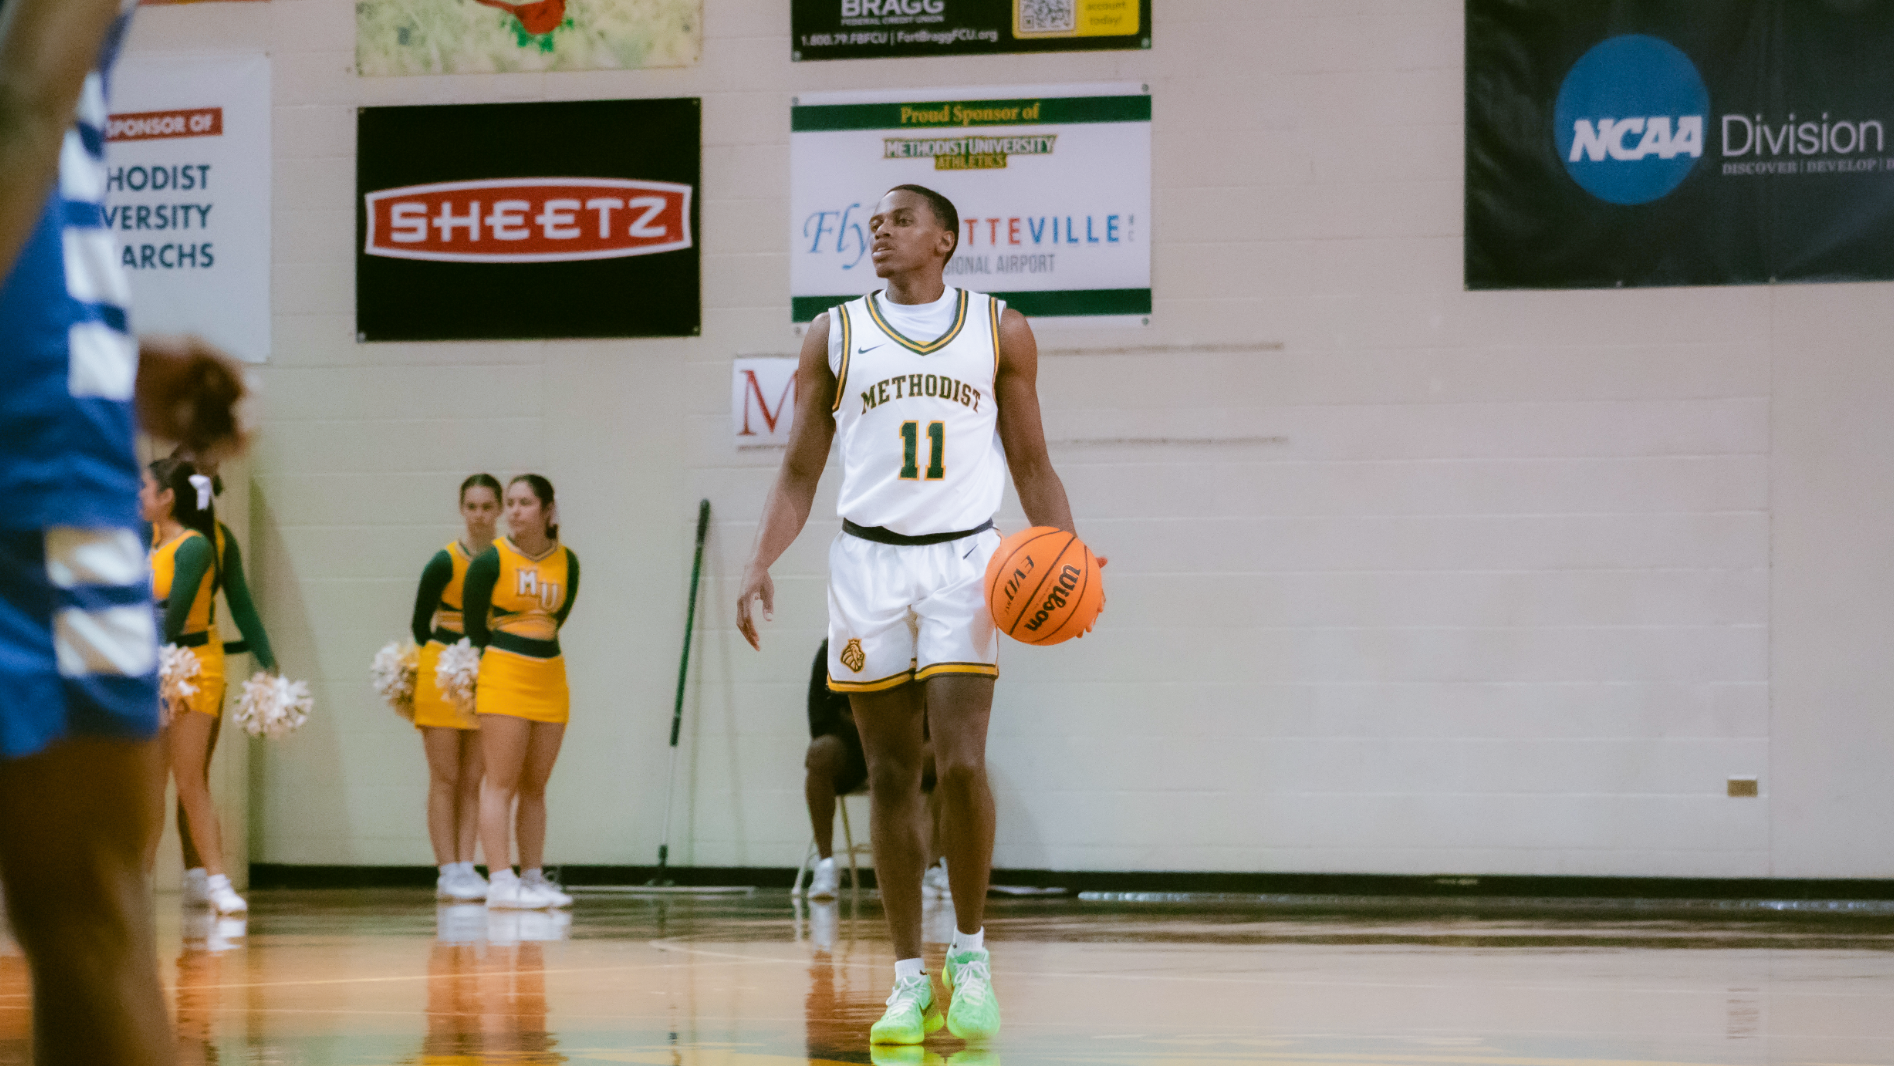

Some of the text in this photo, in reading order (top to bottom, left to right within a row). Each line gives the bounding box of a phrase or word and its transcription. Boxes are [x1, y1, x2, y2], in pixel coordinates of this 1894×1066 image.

[841, 0, 945, 17] BRAGG
[901, 102, 1039, 126] Proud Sponsor of
[885, 136, 1055, 157] METHODIST UNIVERSITY
[1569, 112, 1884, 162] NCAA Division
[1722, 160, 1797, 175] DISCOVER
[1806, 158, 1877, 173] DEVELOP
[390, 196, 668, 242] SHEETZ
[803, 202, 872, 270] Fly
[964, 214, 1119, 246] TTEVILLE
[997, 253, 1055, 274] AIRPORT
[860, 373, 981, 415] METHODIST
[897, 419, 947, 481] 11
[1024, 563, 1081, 632] Wilson
